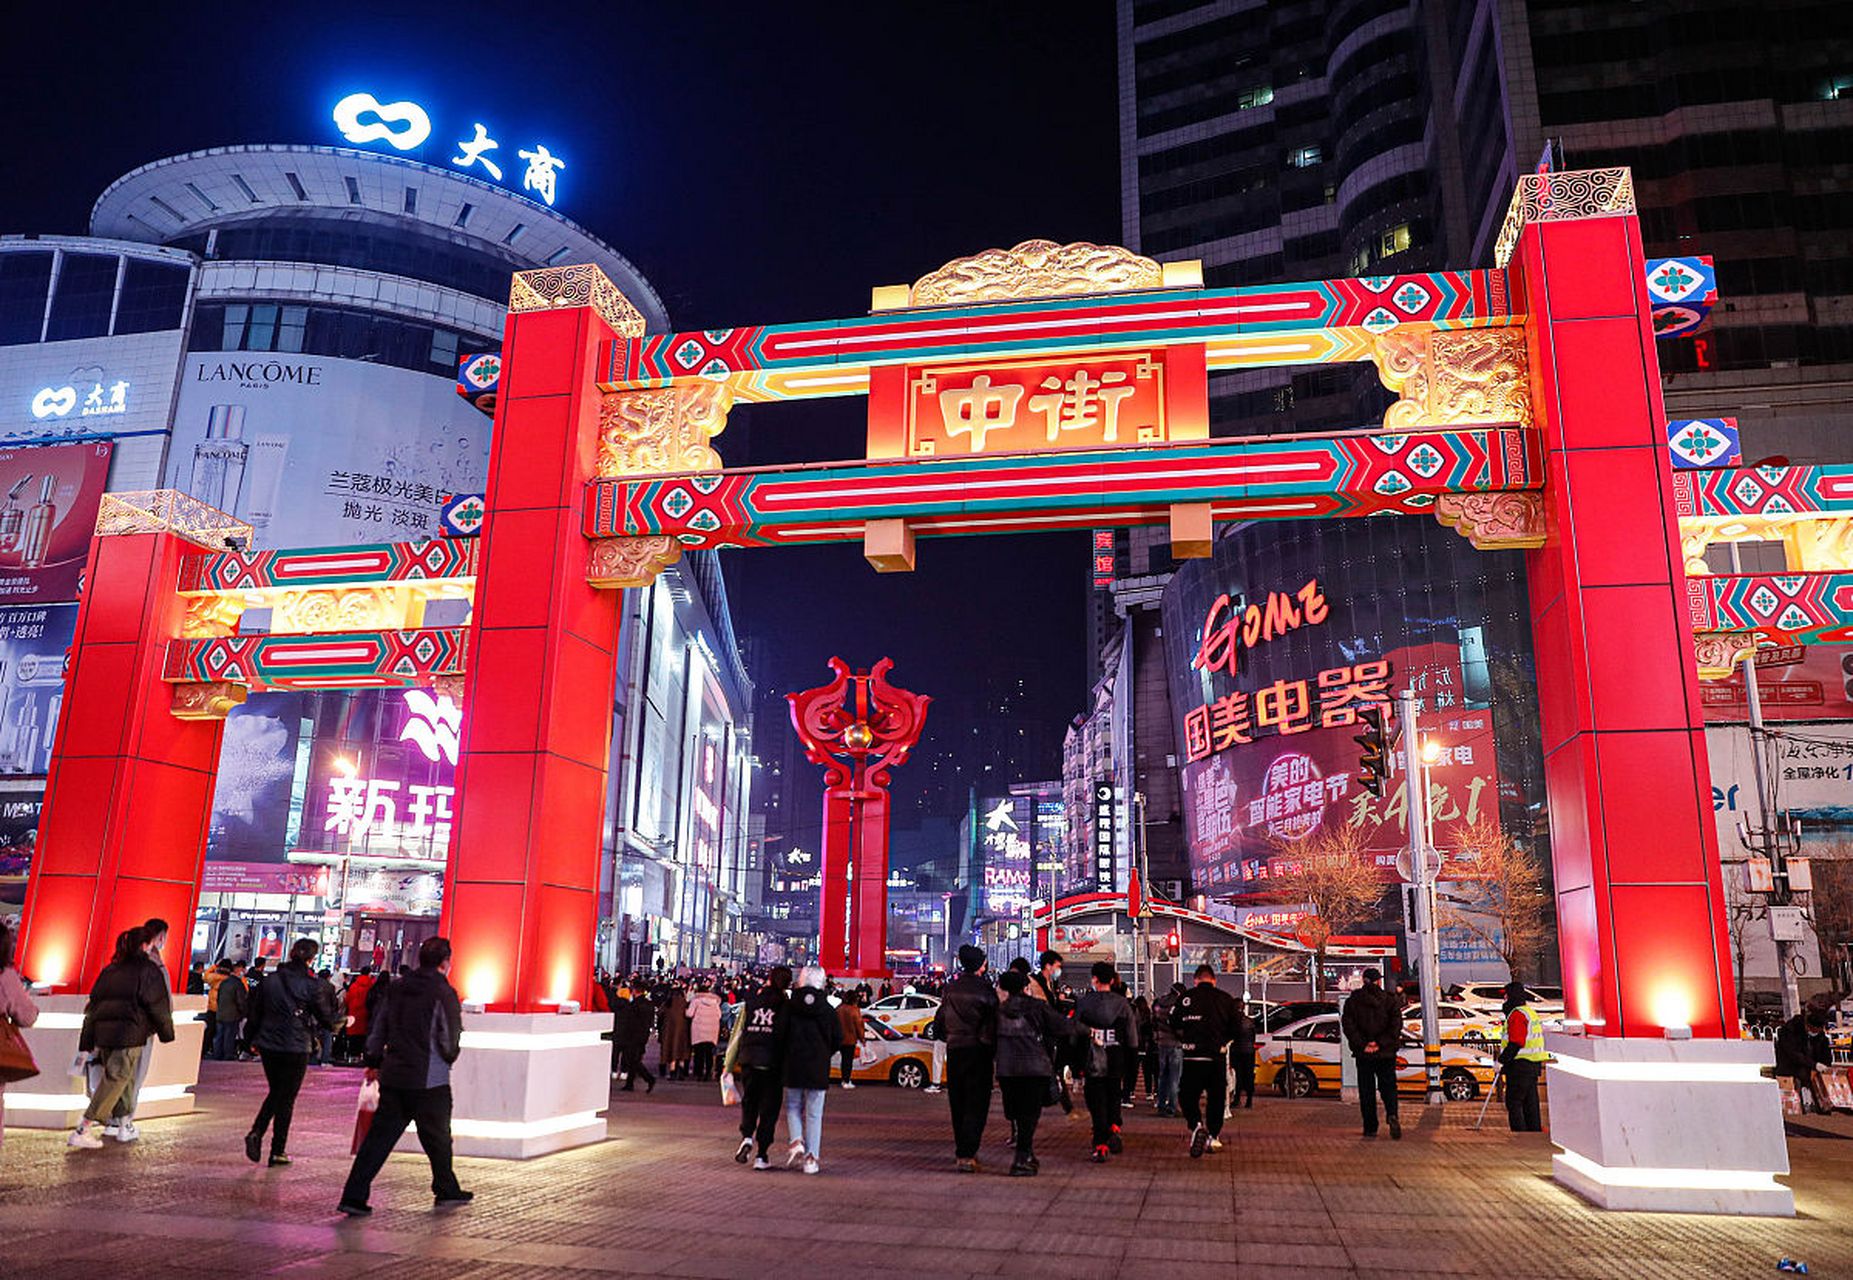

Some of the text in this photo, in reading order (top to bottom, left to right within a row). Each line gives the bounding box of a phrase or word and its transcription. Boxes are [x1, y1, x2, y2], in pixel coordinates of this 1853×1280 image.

[452, 122, 565, 206] 大商
[197, 360, 323, 386] LANCÔME
[939, 369, 1135, 453] 中街
[328, 470, 464, 505] 兰蔻极光美白
[1184, 660, 1393, 764] 国美电器
[1248, 772, 1350, 828] 智能家电节
[1270, 755, 1310, 792] 美的
